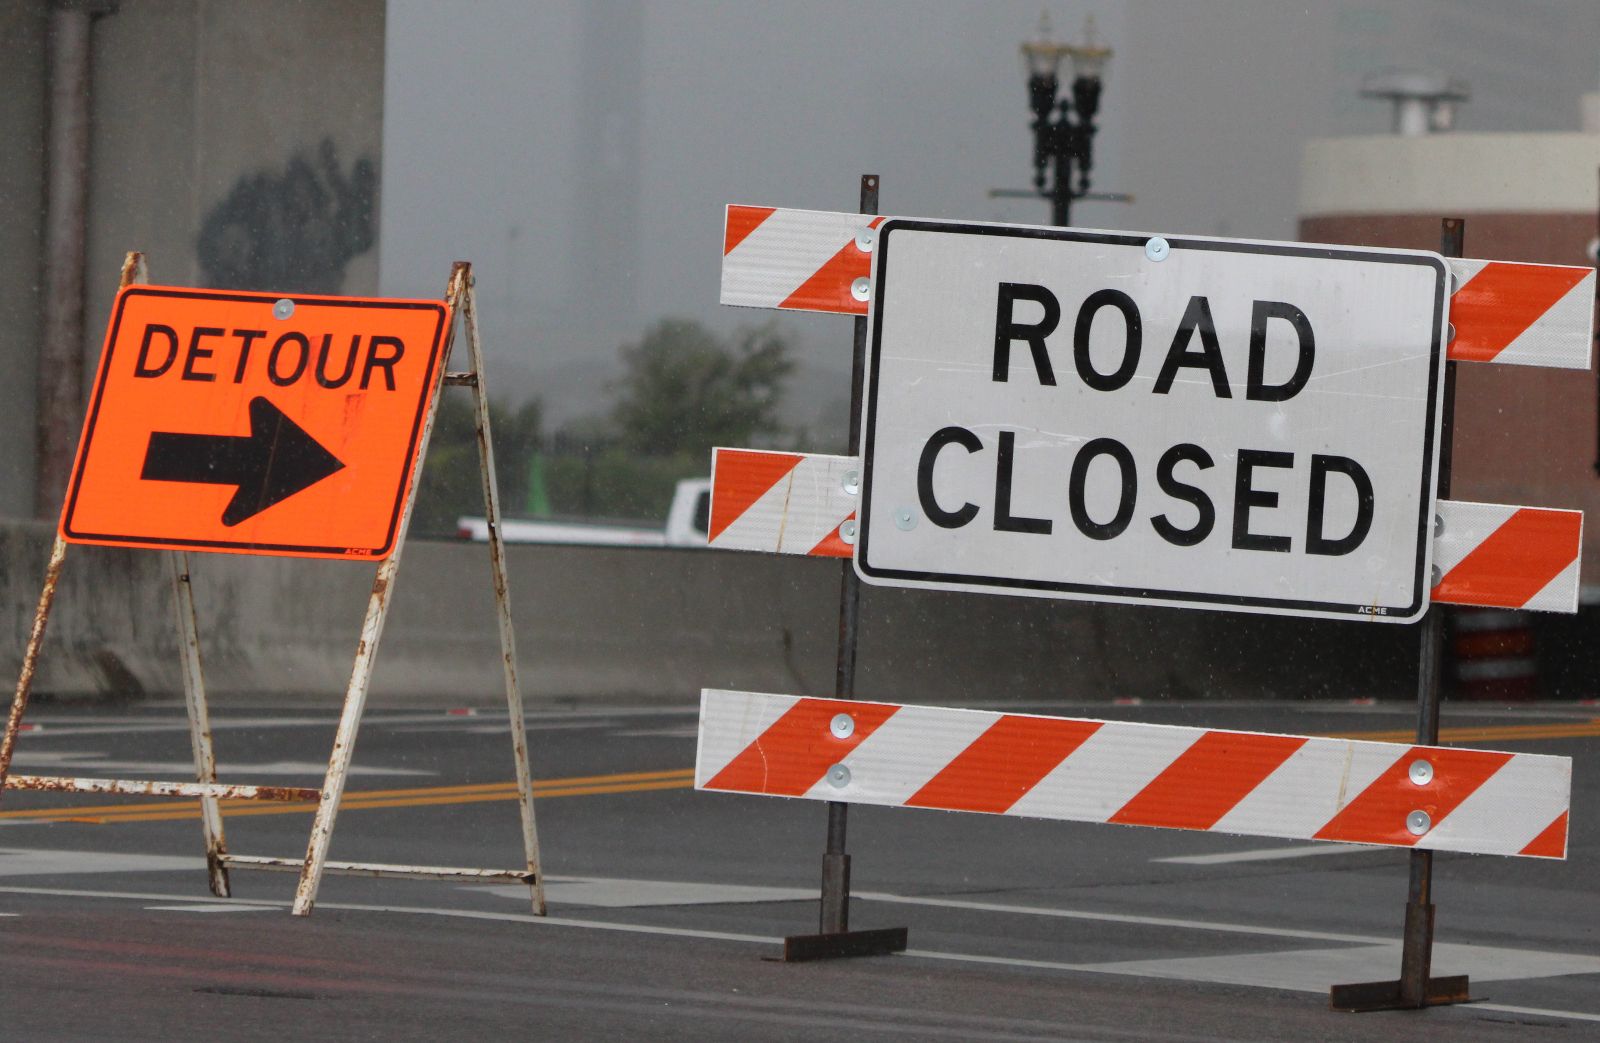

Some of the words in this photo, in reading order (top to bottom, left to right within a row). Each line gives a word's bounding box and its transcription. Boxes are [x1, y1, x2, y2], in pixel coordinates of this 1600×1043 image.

[134, 323, 405, 391] DETOUR
[992, 281, 1316, 403] ROAD
[916, 426, 1375, 557] CLOSED
[1358, 606, 1388, 615] ACME
